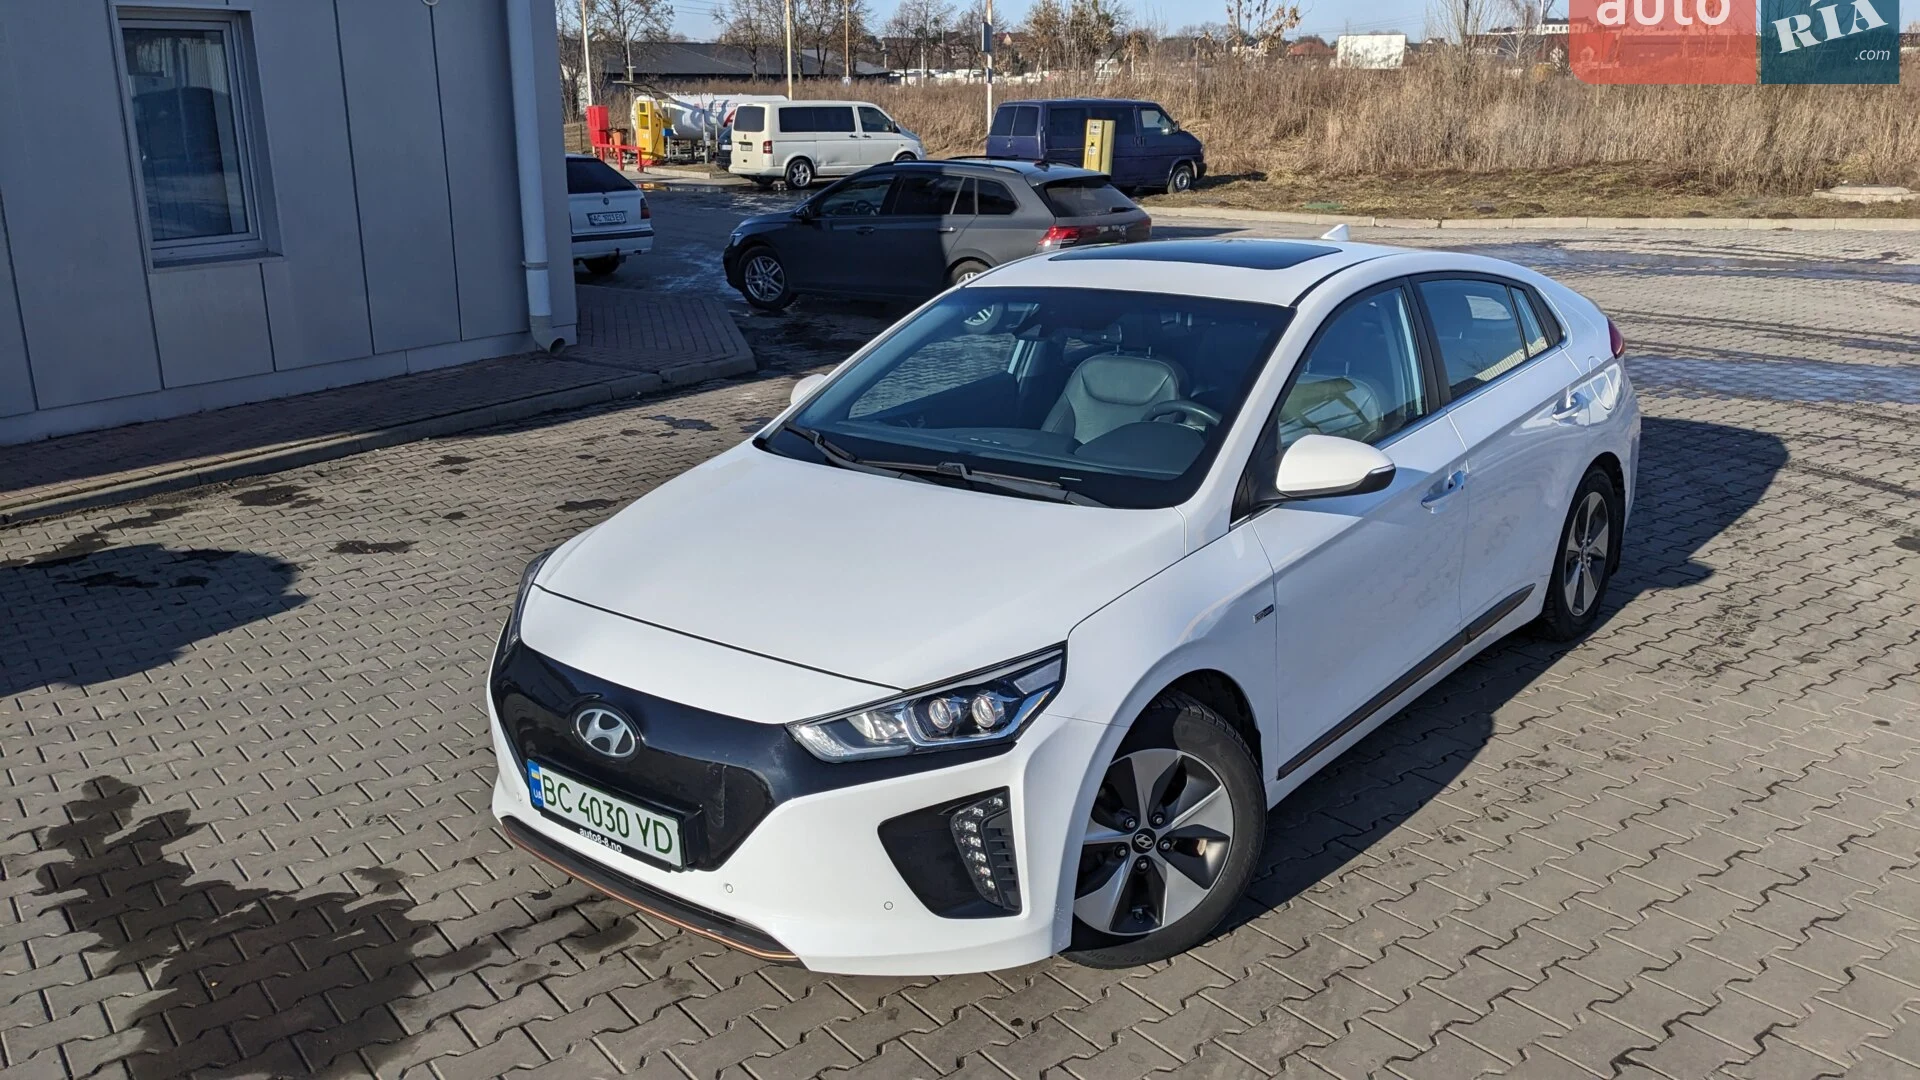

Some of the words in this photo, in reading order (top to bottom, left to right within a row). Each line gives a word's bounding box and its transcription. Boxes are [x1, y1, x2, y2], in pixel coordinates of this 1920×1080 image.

[533, 788, 542, 801] UA
[542, 774, 572, 813] BC
[578, 792, 629, 838] 4030
[636, 813, 672, 854] YD
